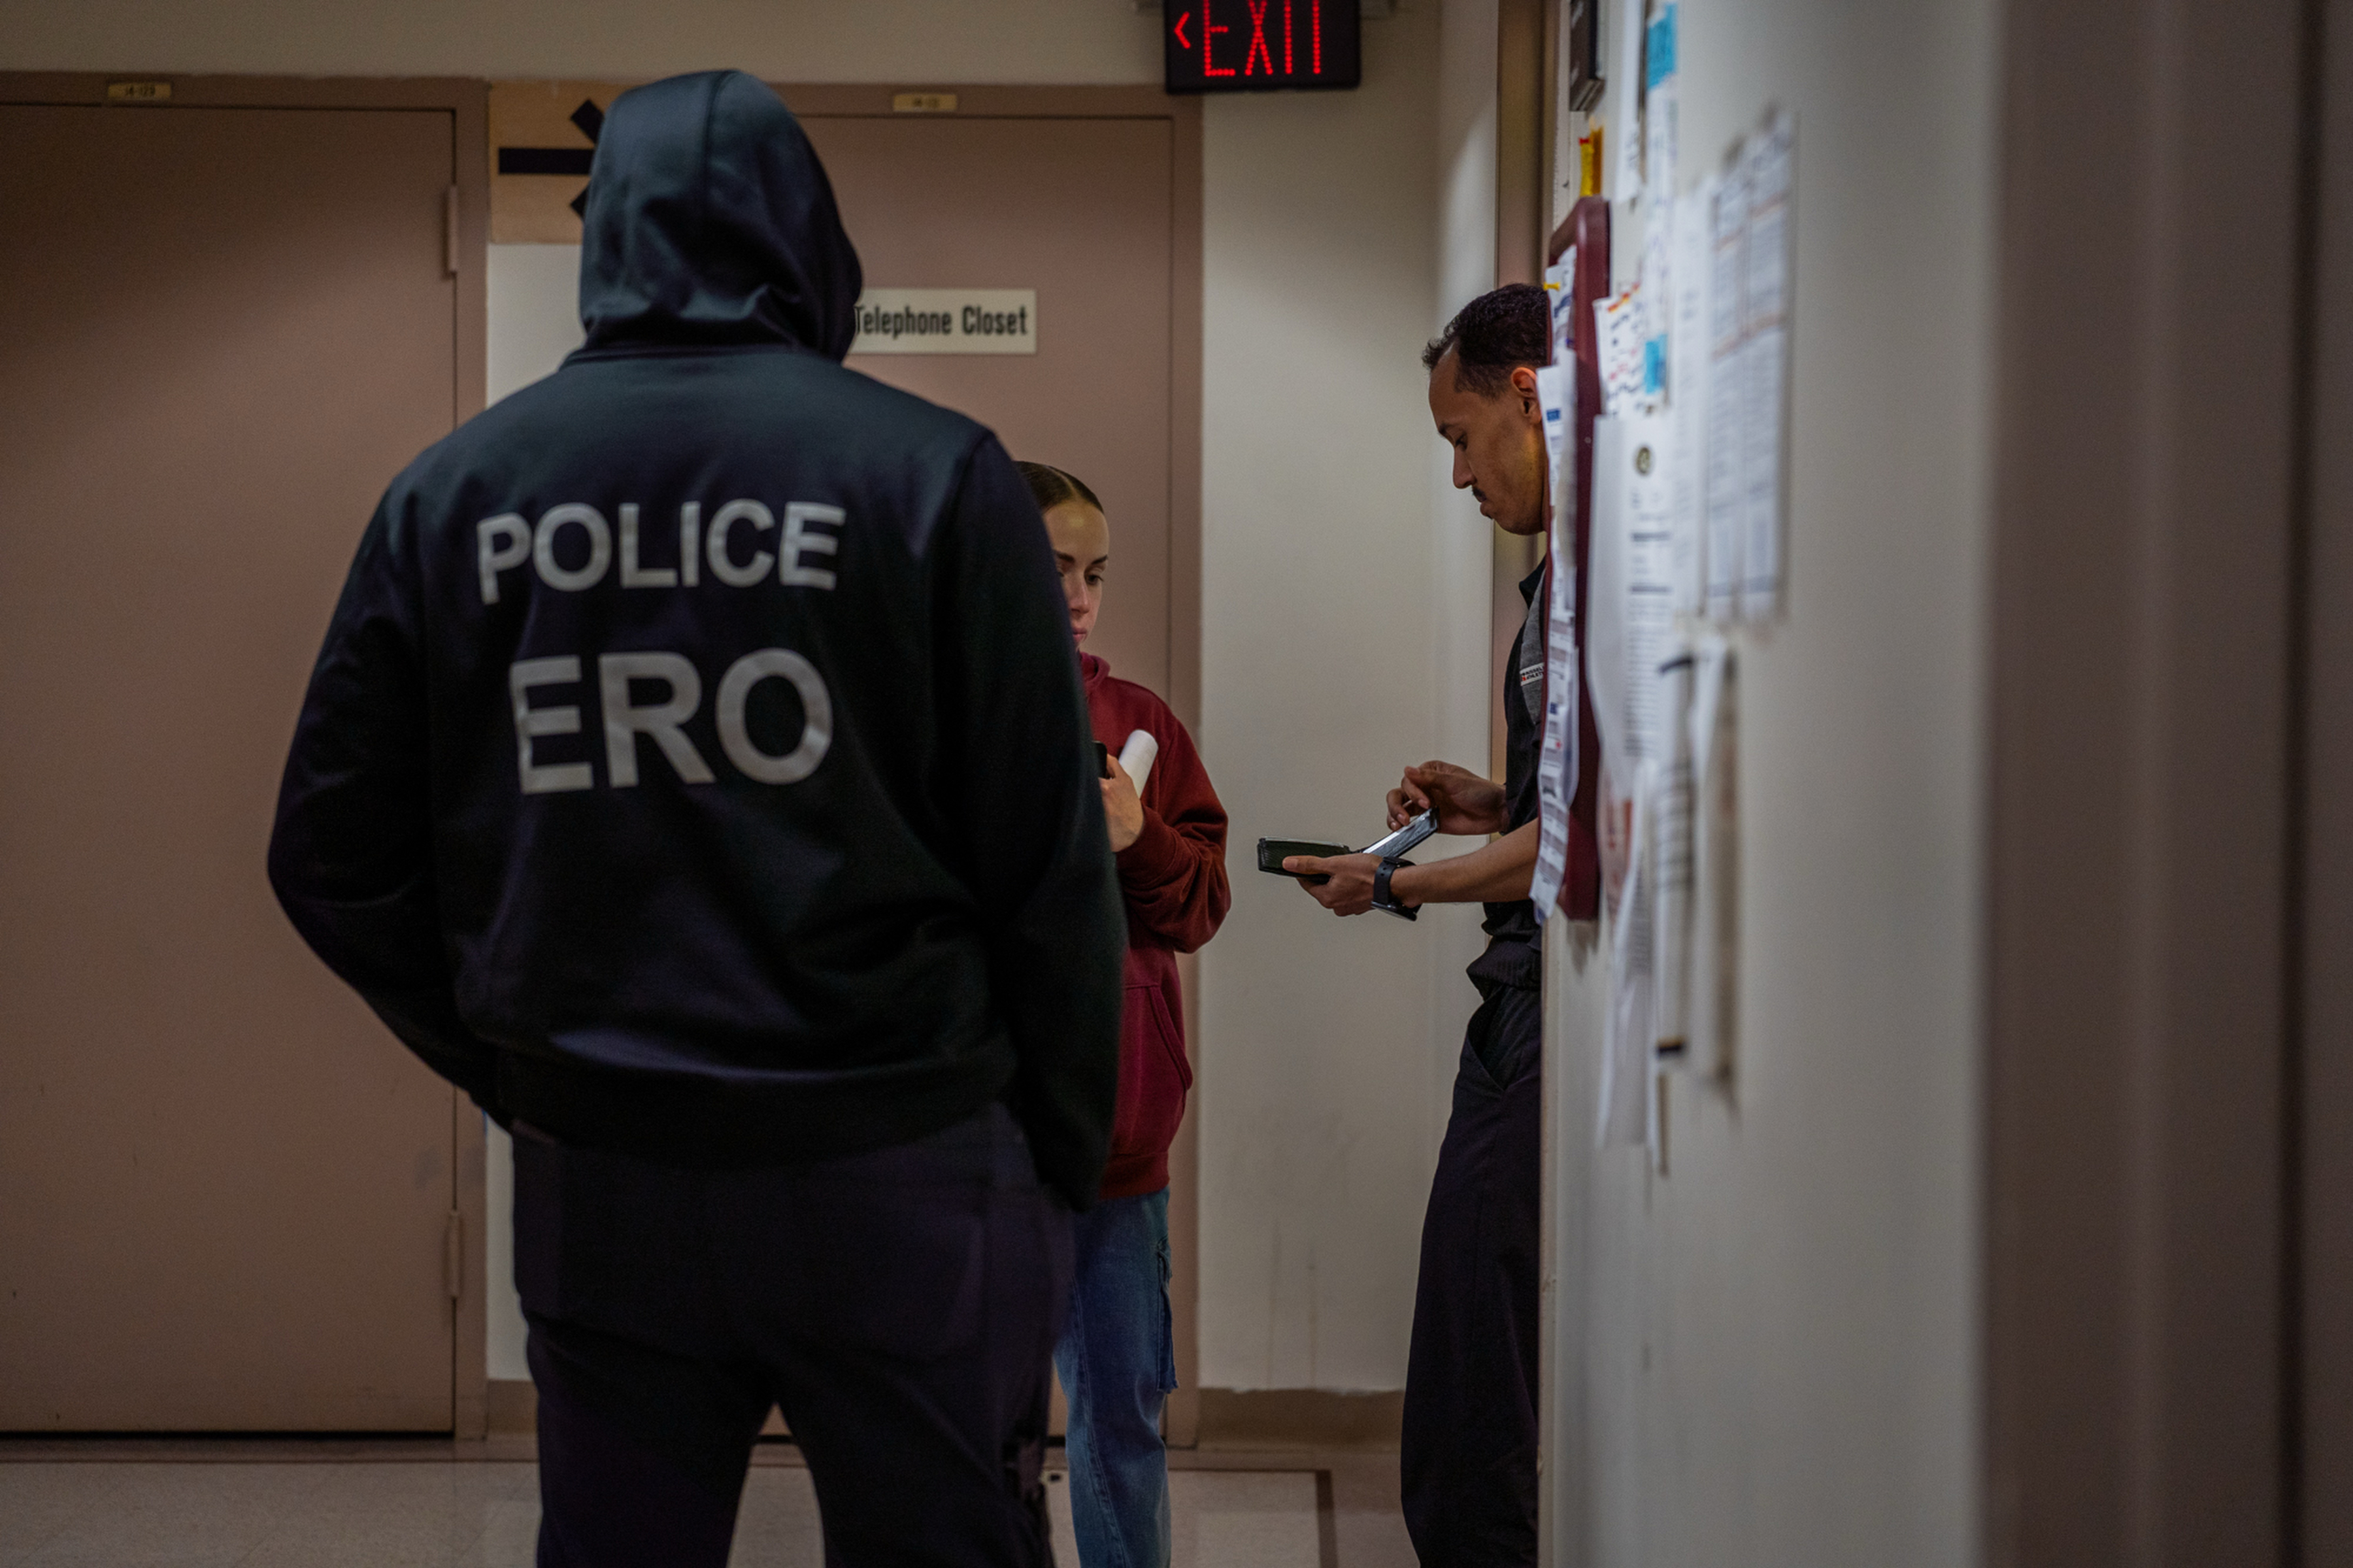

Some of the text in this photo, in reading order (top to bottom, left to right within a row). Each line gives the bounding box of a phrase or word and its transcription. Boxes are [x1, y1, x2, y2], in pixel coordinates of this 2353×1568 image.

[853, 305, 1027, 340] Telephone Closet
[477, 499, 846, 605] POLICE
[509, 647, 833, 795] ERO
